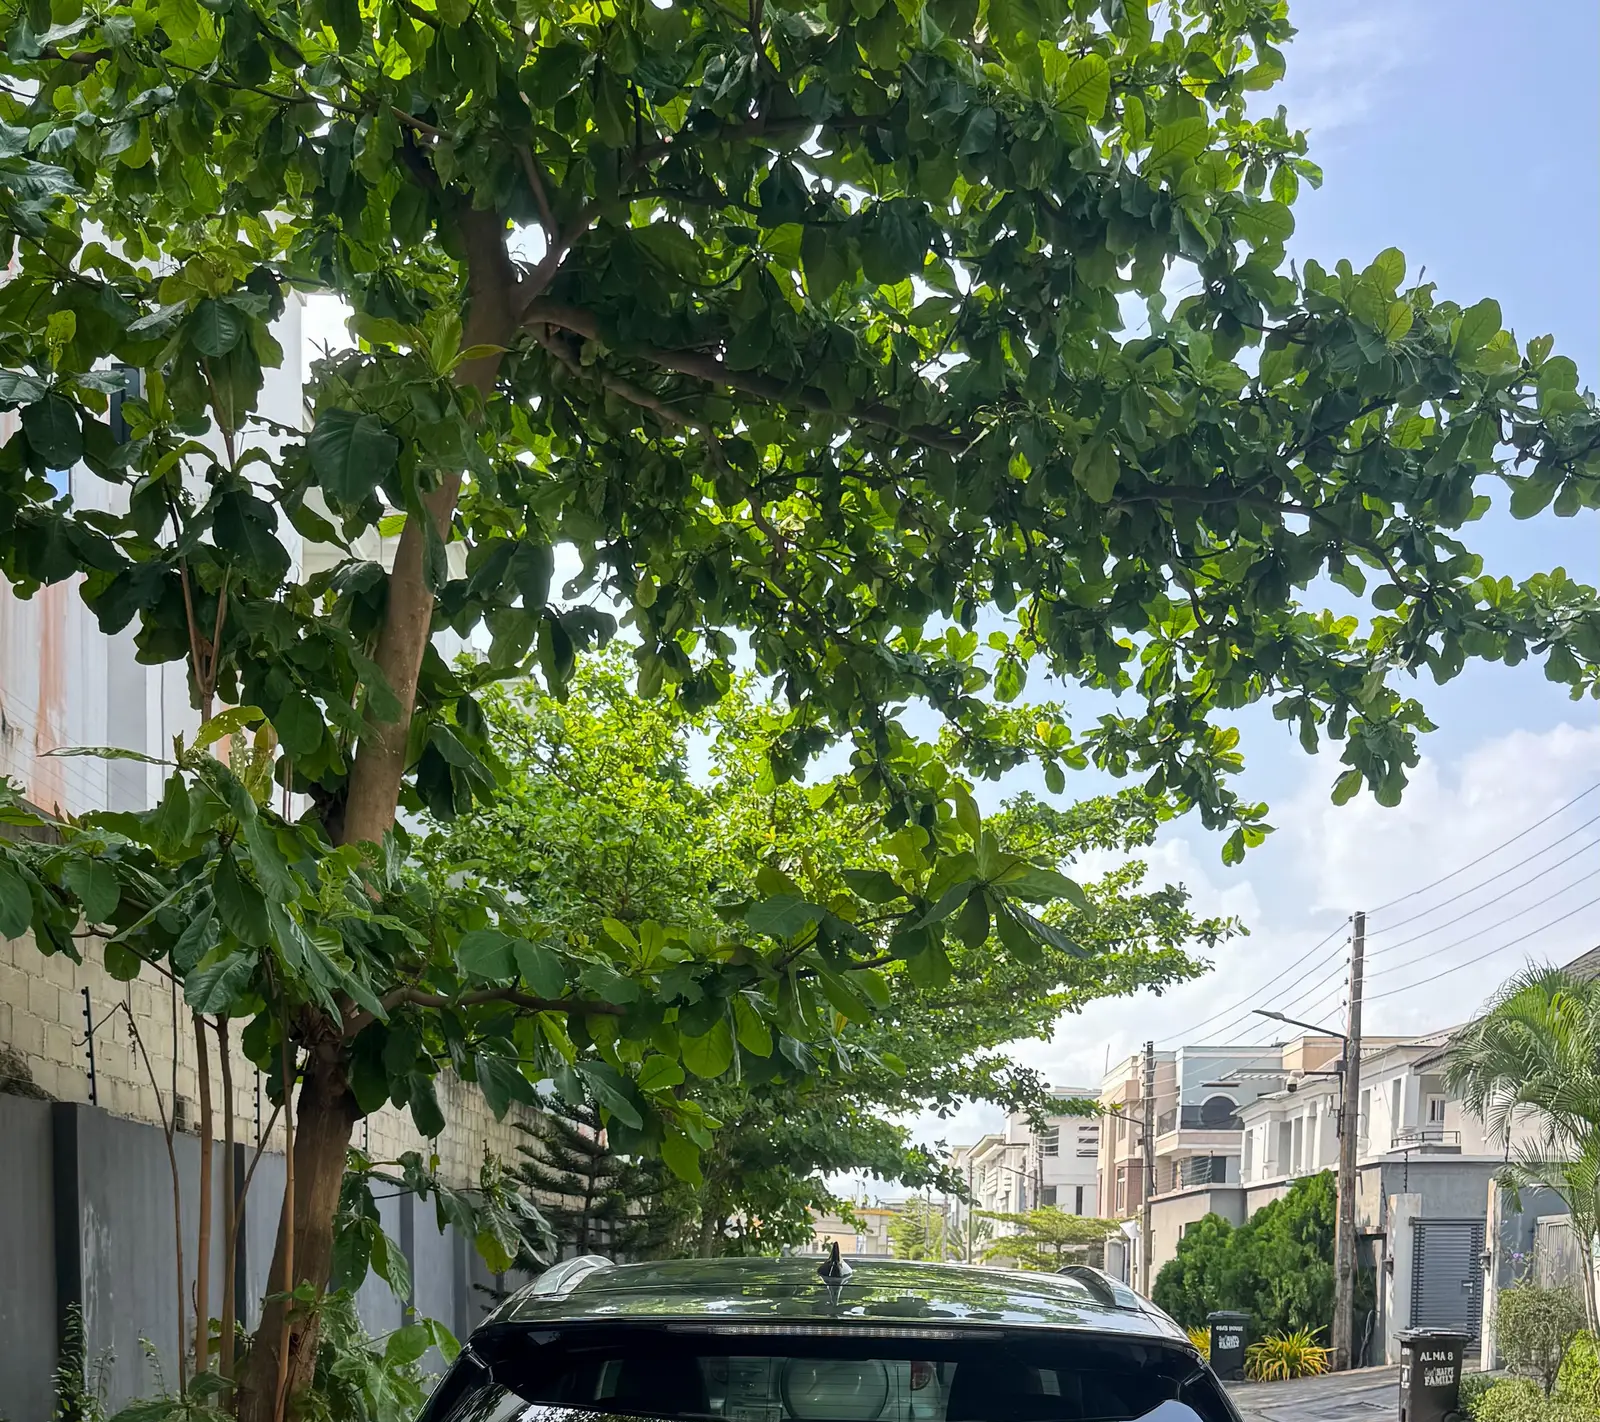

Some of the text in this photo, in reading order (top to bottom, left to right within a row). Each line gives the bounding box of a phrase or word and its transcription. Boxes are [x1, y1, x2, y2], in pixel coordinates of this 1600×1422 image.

[1420, 1351, 1446, 1361] ALMA
[1447, 1351, 1454, 1361] 8
[1424, 1375, 1454, 1386] FAMILY
